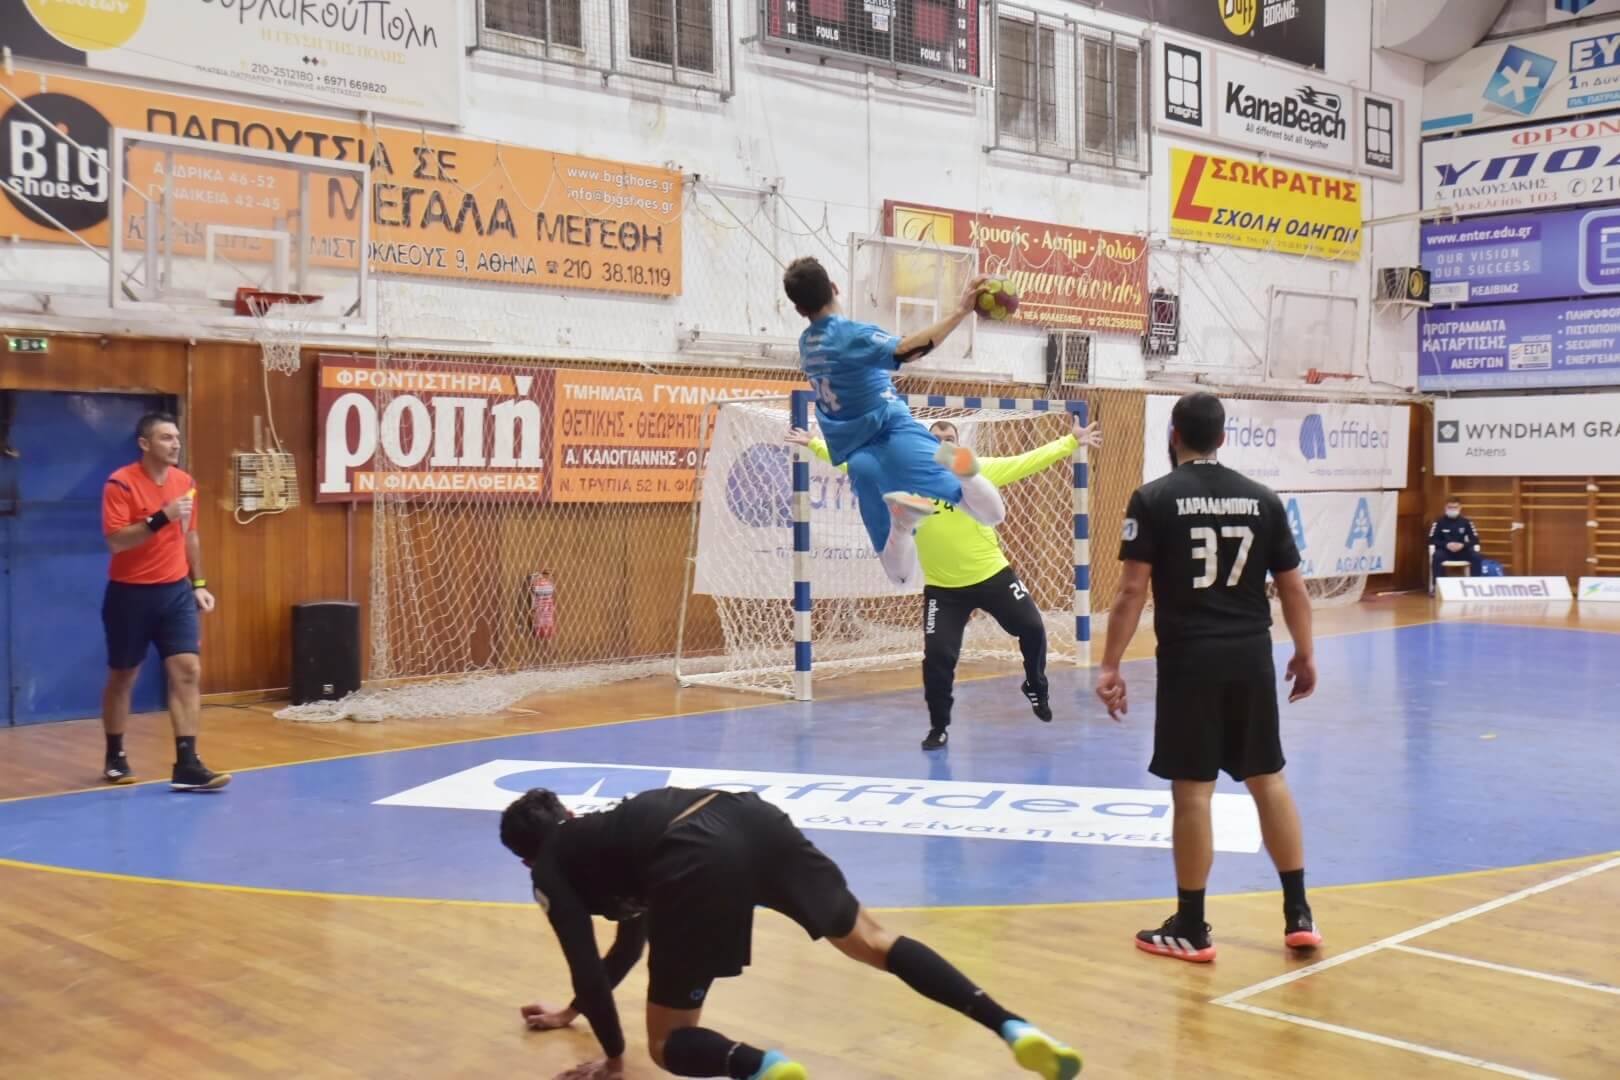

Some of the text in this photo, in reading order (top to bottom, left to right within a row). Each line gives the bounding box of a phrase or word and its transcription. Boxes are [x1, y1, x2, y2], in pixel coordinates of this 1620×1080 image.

[816, 26, 839, 42] FOULS
[920, 47, 941, 62] FOULS
[1226, 81, 1346, 141] KanaBeach
[10, 120, 109, 203] Big
[413, 146, 458, 184] ΣΕ
[9, 175, 90, 203] shoes
[567, 164, 675, 191] www.bigshoes.gr
[1211, 158, 1358, 203] ΣΩΚΡΑΤΗΣ
[1452, 178, 1549, 199] ΠΑΝΟΥΣΑΚΗΣ
[1592, 175, 1620, 193] 21
[567, 188, 675, 214] info@bigshoes.gr
[328, 177, 663, 252] ΜΕΓΑΛΑ ΜΕΓΕΘΗ
[1213, 208, 1282, 233] ΣΧΟΛΗ
[1286, 219, 1359, 244] ΟΔΗΓΩΝ
[969, 219, 1030, 252] Χρυσός
[1041, 230, 1087, 260] Ασήμι
[1097, 238, 1137, 261] Ρολόι
[1427, 225, 1533, 246] www.enter.edu.gr
[1437, 247, 1519, 265] OUR VISION
[1468, 259, 1531, 276] SUCCESS
[477, 257, 537, 276] ΑΘΗΝΑ
[563, 257, 592, 281] 210
[602, 263, 671, 288] 38.18.119
[1423, 320, 1506, 335] ΠΡΟΓΡΑΜΜΑΤΑ
[1422, 335, 1507, 352] ΚΑΤΑΡΤΙΣΗΣ
[1451, 356, 1504, 370] ΑΝΕΡΓΩΝ
[336, 368, 502, 393] ΦΡΟΝΤΙΣΤΗΡΙΑ
[563, 383, 644, 402] ΤΜΗΜΑΤΑ
[320, 375, 544, 493] ροπή
[562, 409, 625, 438] ΘΕΤΙΚΗΣ
[1225, 416, 1277, 447] fidea
[1328, 420, 1389, 449] affidea
[1466, 422, 1575, 439] WYNDHAM
[584, 452, 677, 467] ΚΑΛΟΓΙΑΝΝΗΣ
[1465, 447, 1507, 457] Athens
[384, 474, 540, 491] ΦΙΛΑΔΕΛΦΕΙΑΣ
[580, 479, 631, 492] ΤΡΥΠΙΑ
[637, 479, 651, 492] 52
[1190, 526, 1255, 588] 37
[1459, 579, 1550, 597] hummel
[926, 598, 937, 634] Kempa
